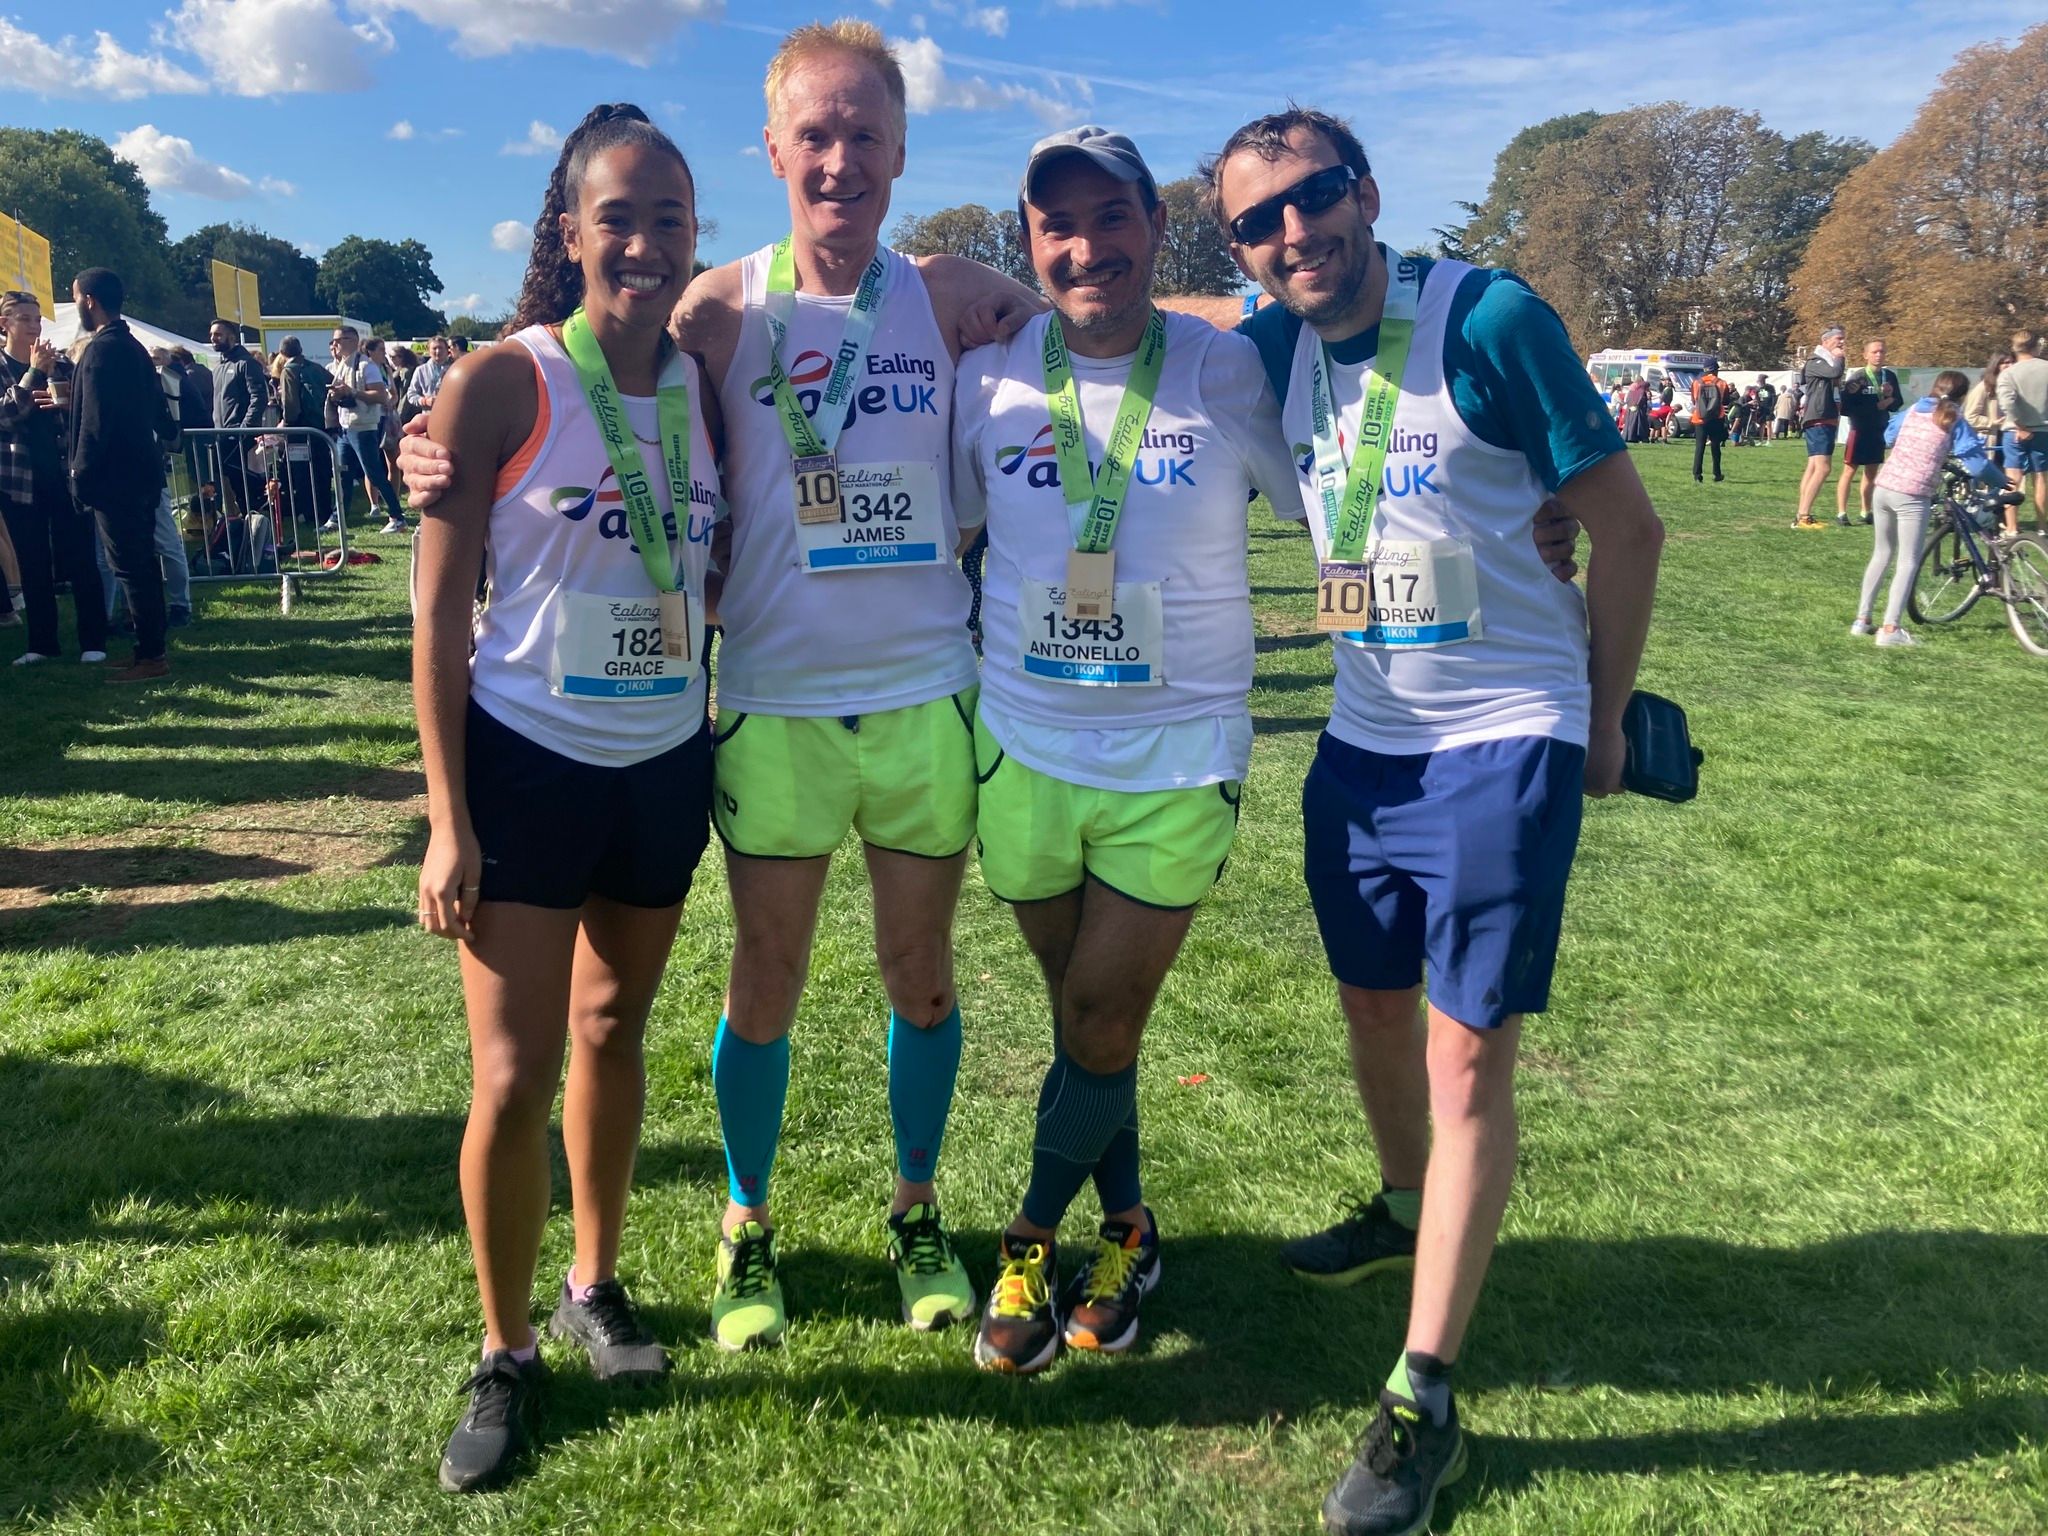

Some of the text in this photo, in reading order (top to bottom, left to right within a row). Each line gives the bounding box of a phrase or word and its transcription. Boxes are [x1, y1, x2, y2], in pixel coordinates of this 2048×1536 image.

[839, 339, 859, 362] 10
[1046, 349, 1062, 373] 10
[866, 353, 935, 382] Ealing
[826, 359, 851, 406] ANNIVERSARY
[892, 384, 938, 415] UK
[1366, 397, 1376, 420] 25TH
[1375, 372, 1392, 420] SEPTEMBER
[593, 376, 625, 460] Ealing
[1058, 380, 1075, 457] Ealing
[1361, 421, 1381, 448] 10
[1107, 410, 1141, 486] Ealing
[624, 470, 648, 496] 10
[1135, 458, 1197, 486] UK
[1320, 466, 1336, 490] 10
[1384, 463, 1441, 497] UK
[672, 481, 685, 504] 10
[797, 473, 837, 507] 10
[1097, 497, 1118, 522] 10
[1341, 461, 1374, 547] Ealing
[635, 497, 655, 543] SEPTEMBER
[1083, 518, 1094, 537] 2022
[842, 526, 906, 544] JAMES
[1100, 523, 1111, 543] 25TH
[869, 545, 899, 558] IKON
[1321, 566, 1366, 578] Ealing
[1320, 581, 1365, 614] 10
[608, 602, 661, 622] Ealing
[1367, 606, 1436, 623] NDREW
[1043, 611, 1125, 642] 1343
[1387, 627, 1418, 639] IKON
[612, 628, 663, 657] 182
[1030, 641, 1140, 662] ANTONELLO
[604, 660, 665, 677] GRACE
[1075, 664, 1105, 676] IKON
[628, 680, 654, 691] IKON
